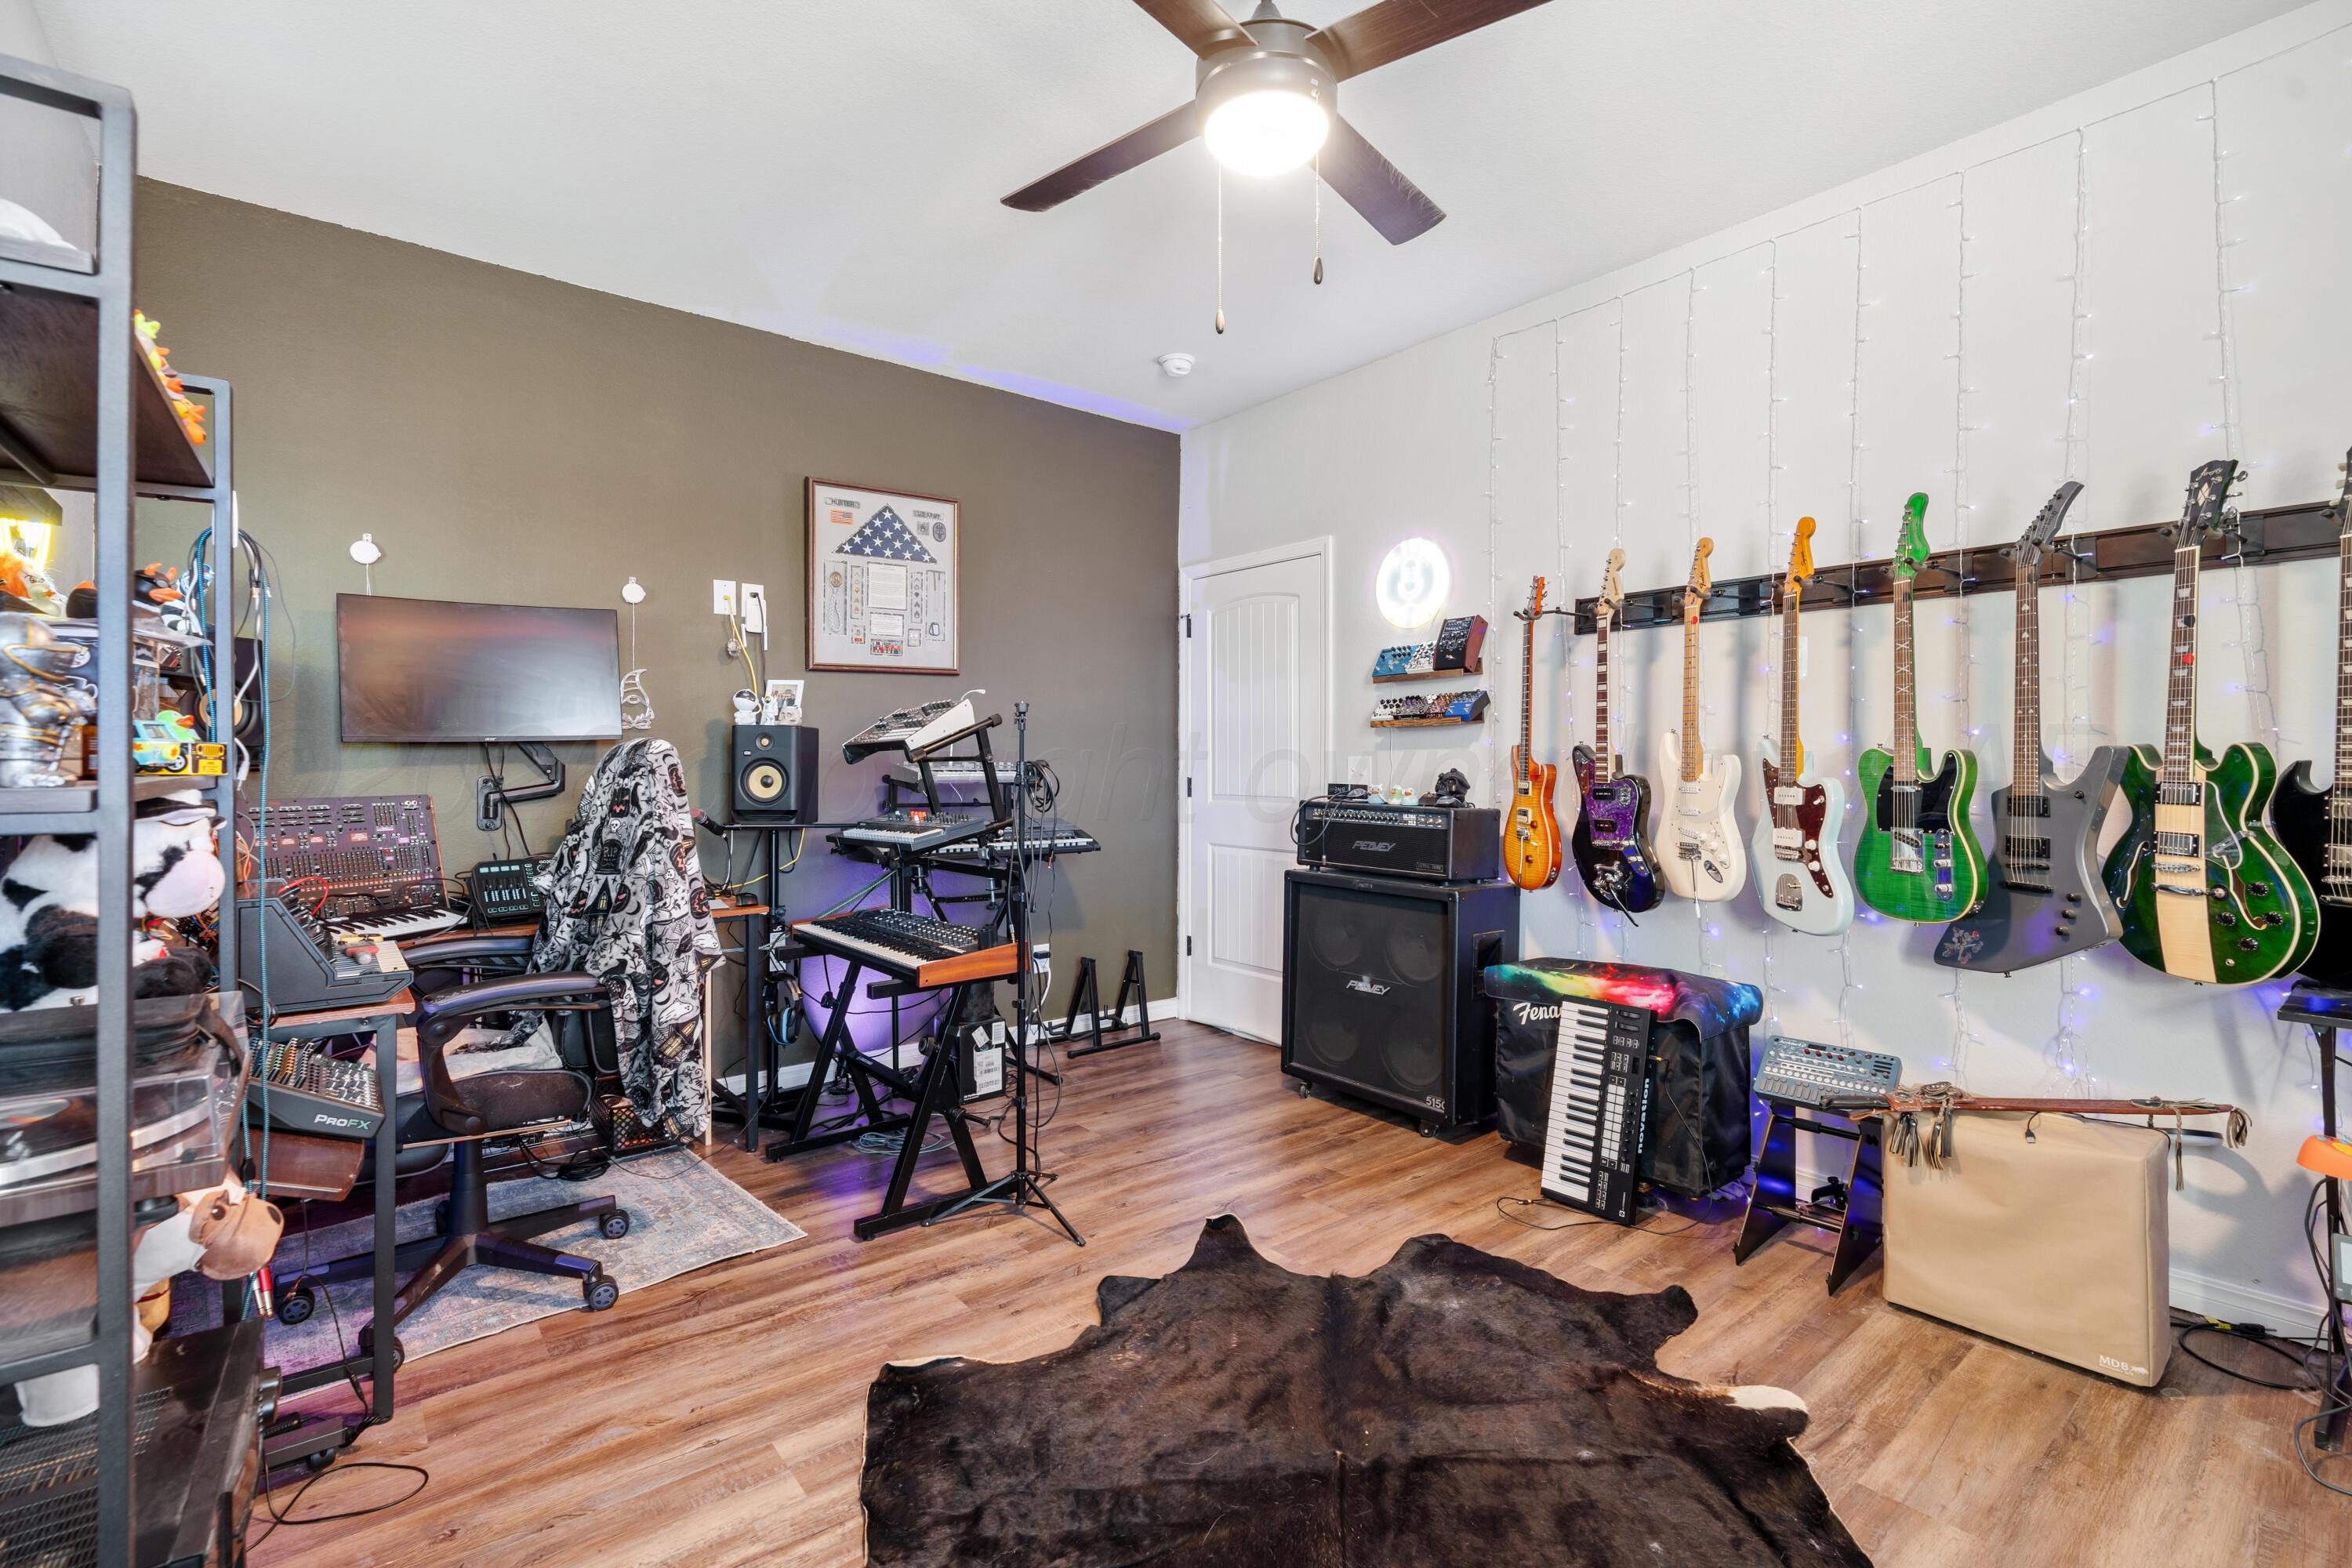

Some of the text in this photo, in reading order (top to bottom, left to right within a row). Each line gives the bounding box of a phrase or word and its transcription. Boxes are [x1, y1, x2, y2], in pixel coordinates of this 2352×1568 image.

[831, 498, 855, 508] HUNTER
[603, 846, 619, 858] RIP
[1352, 840, 1397, 853] PEAVEY
[1345, 979, 1392, 996] PEAVEY
[1638, 1078, 1650, 1154] novation
